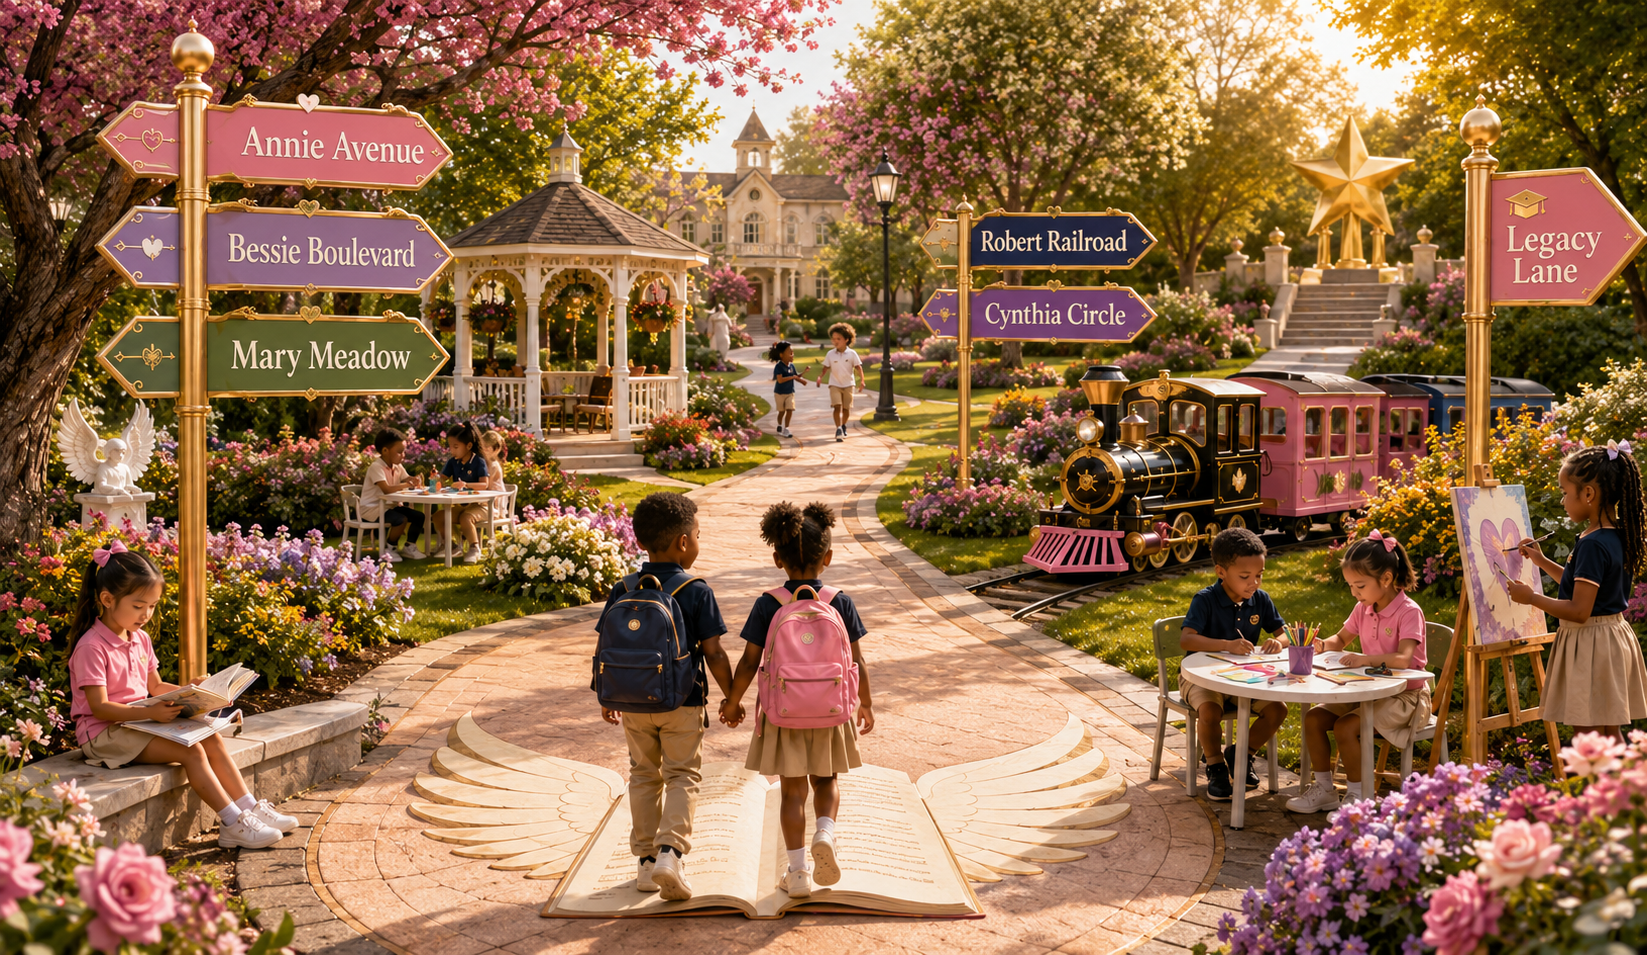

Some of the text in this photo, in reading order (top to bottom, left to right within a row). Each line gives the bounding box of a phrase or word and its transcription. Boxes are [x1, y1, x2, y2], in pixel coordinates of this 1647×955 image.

[241, 127, 424, 164] Annie Avenue
[228, 234, 415, 268] Bessie Boulevard
[981, 229, 1127, 251] Robert Railroad
[1507, 226, 1602, 259] Legacy
[1513, 258, 1577, 283] Lane
[985, 302, 1126, 330] Cynthia Circle
[231, 340, 411, 377] Mary Meadow
